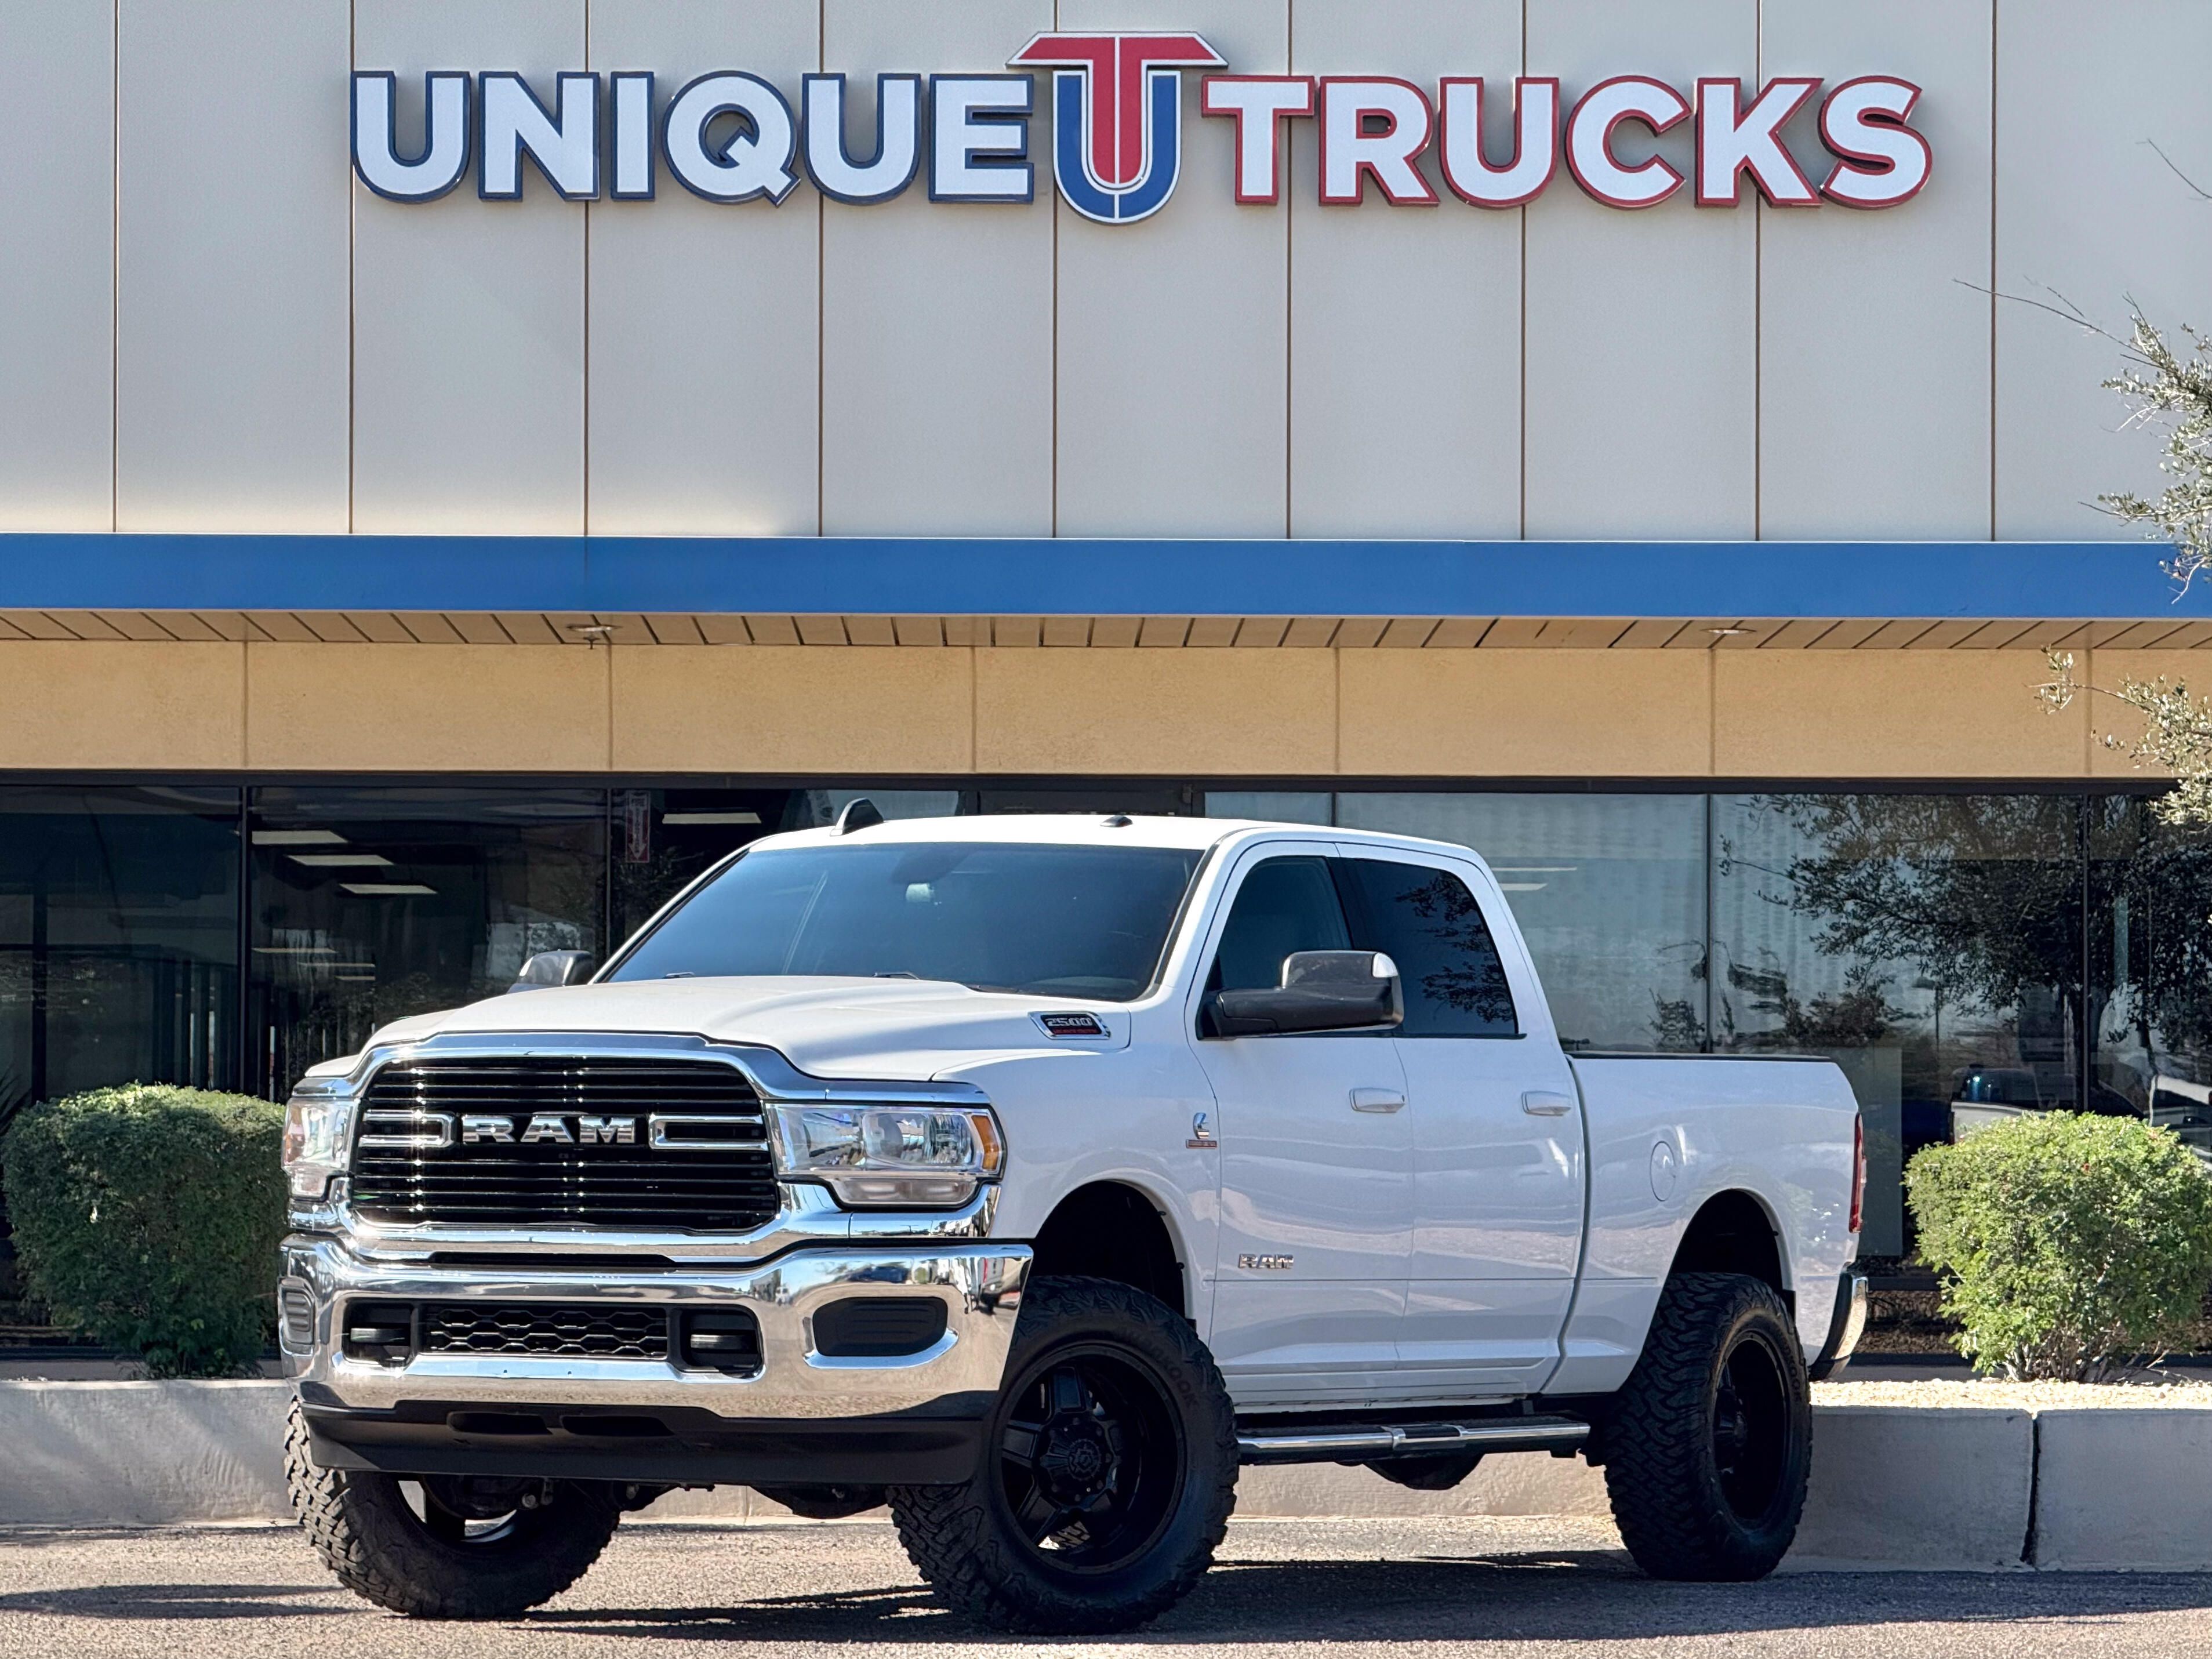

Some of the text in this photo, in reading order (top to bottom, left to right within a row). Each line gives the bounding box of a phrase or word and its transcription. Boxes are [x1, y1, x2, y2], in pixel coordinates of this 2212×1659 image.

[350, 70, 1035, 206] UNIQUE
[1201, 75, 1933, 210] TRUCKS
[1045, 1017, 1093, 1026] 2500
[462, 1115, 635, 1143] RAM
[1238, 1254, 1294, 1269] RAM
